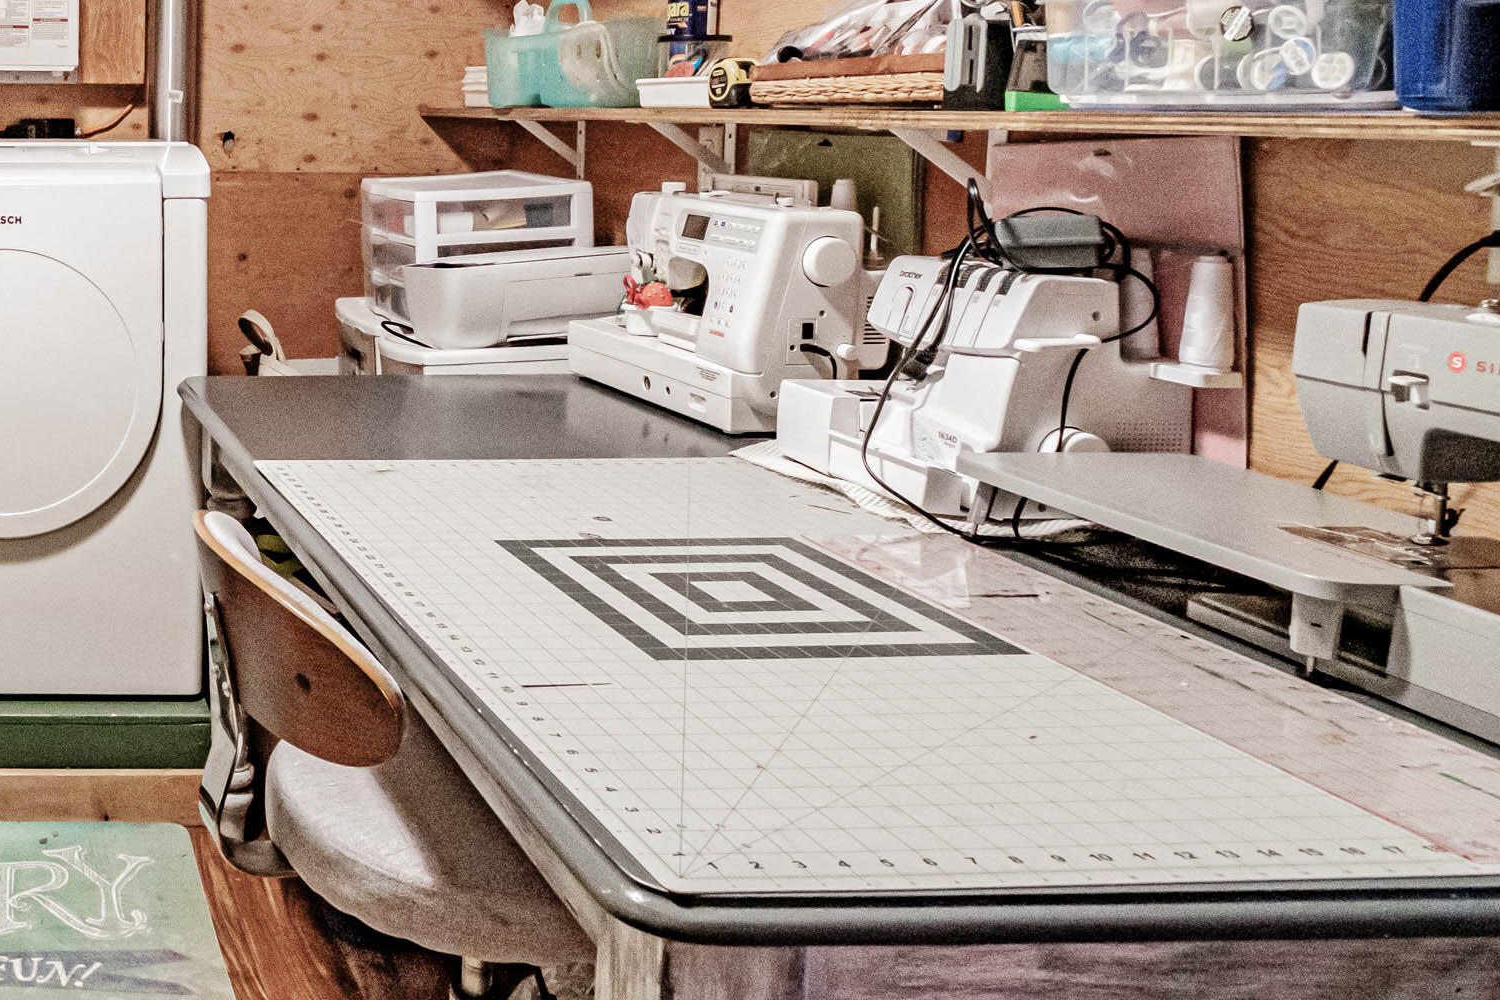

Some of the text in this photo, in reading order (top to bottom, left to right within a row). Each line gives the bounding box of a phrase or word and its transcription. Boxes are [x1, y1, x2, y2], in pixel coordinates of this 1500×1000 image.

[900, 270, 923, 280] brother
[1476, 360, 1500, 375] SI
[707, 862, 718, 870] 1
[749, 861, 764, 870] 2
[792, 860, 807, 868] 3
[838, 860, 851, 868] 4
[880, 859, 895, 867] 5
[922, 858, 938, 866] 6
[964, 856, 978, 864] 7
[1008, 856, 1024, 864] 8
[1050, 854, 1066, 862] 9
[1089, 852, 1114, 862] 10
[1132, 851, 1156, 861] 11
[1174, 850, 1198, 860] 12
[1215, 850, 1241, 859] 13
[1257, 848, 1284, 858] 14
[1298, 847, 1324, 857] 15
[1339, 846, 1366, 856] 16
[1382, 844, 1406, 855] 17
